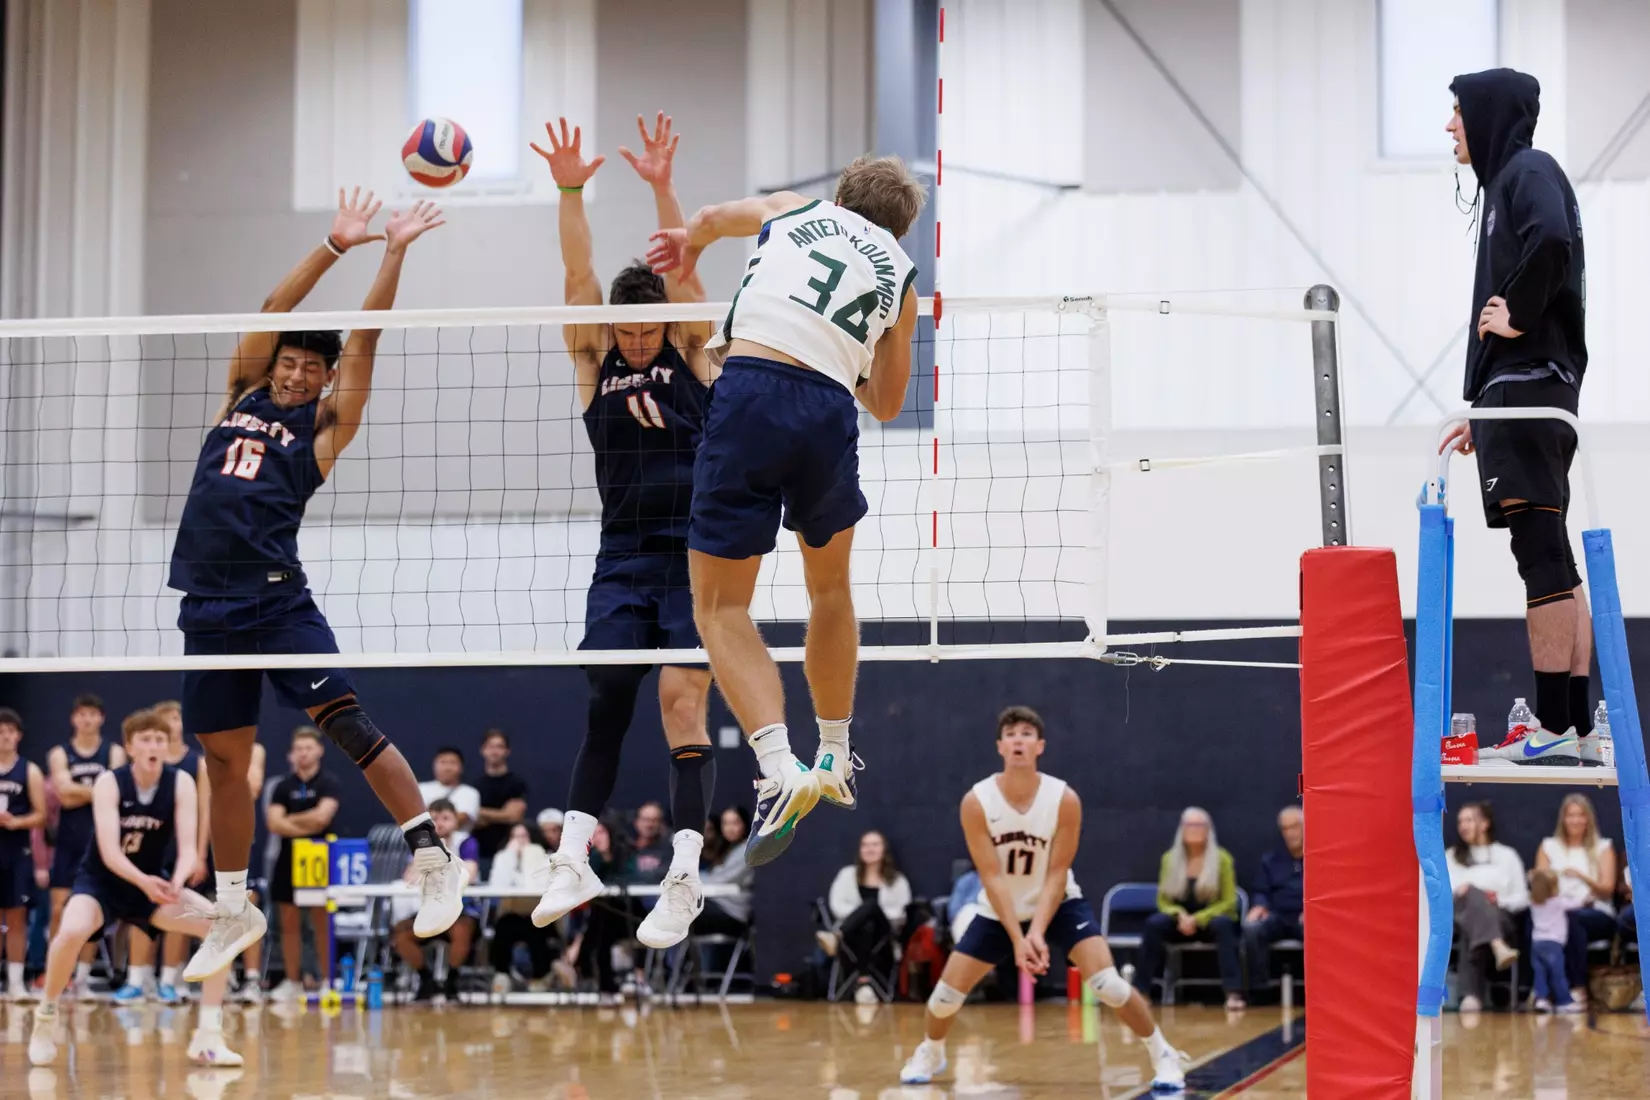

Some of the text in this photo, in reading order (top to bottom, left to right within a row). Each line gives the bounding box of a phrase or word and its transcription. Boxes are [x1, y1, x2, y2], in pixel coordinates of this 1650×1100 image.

[788, 249, 880, 345] 34
[601, 366, 674, 396] LIBETY
[626, 391, 666, 429] 11
[220, 436, 267, 481] 16
[299, 856, 327, 886] 10
[336, 852, 368, 885] 15
[1007, 848, 1034, 876] 17
